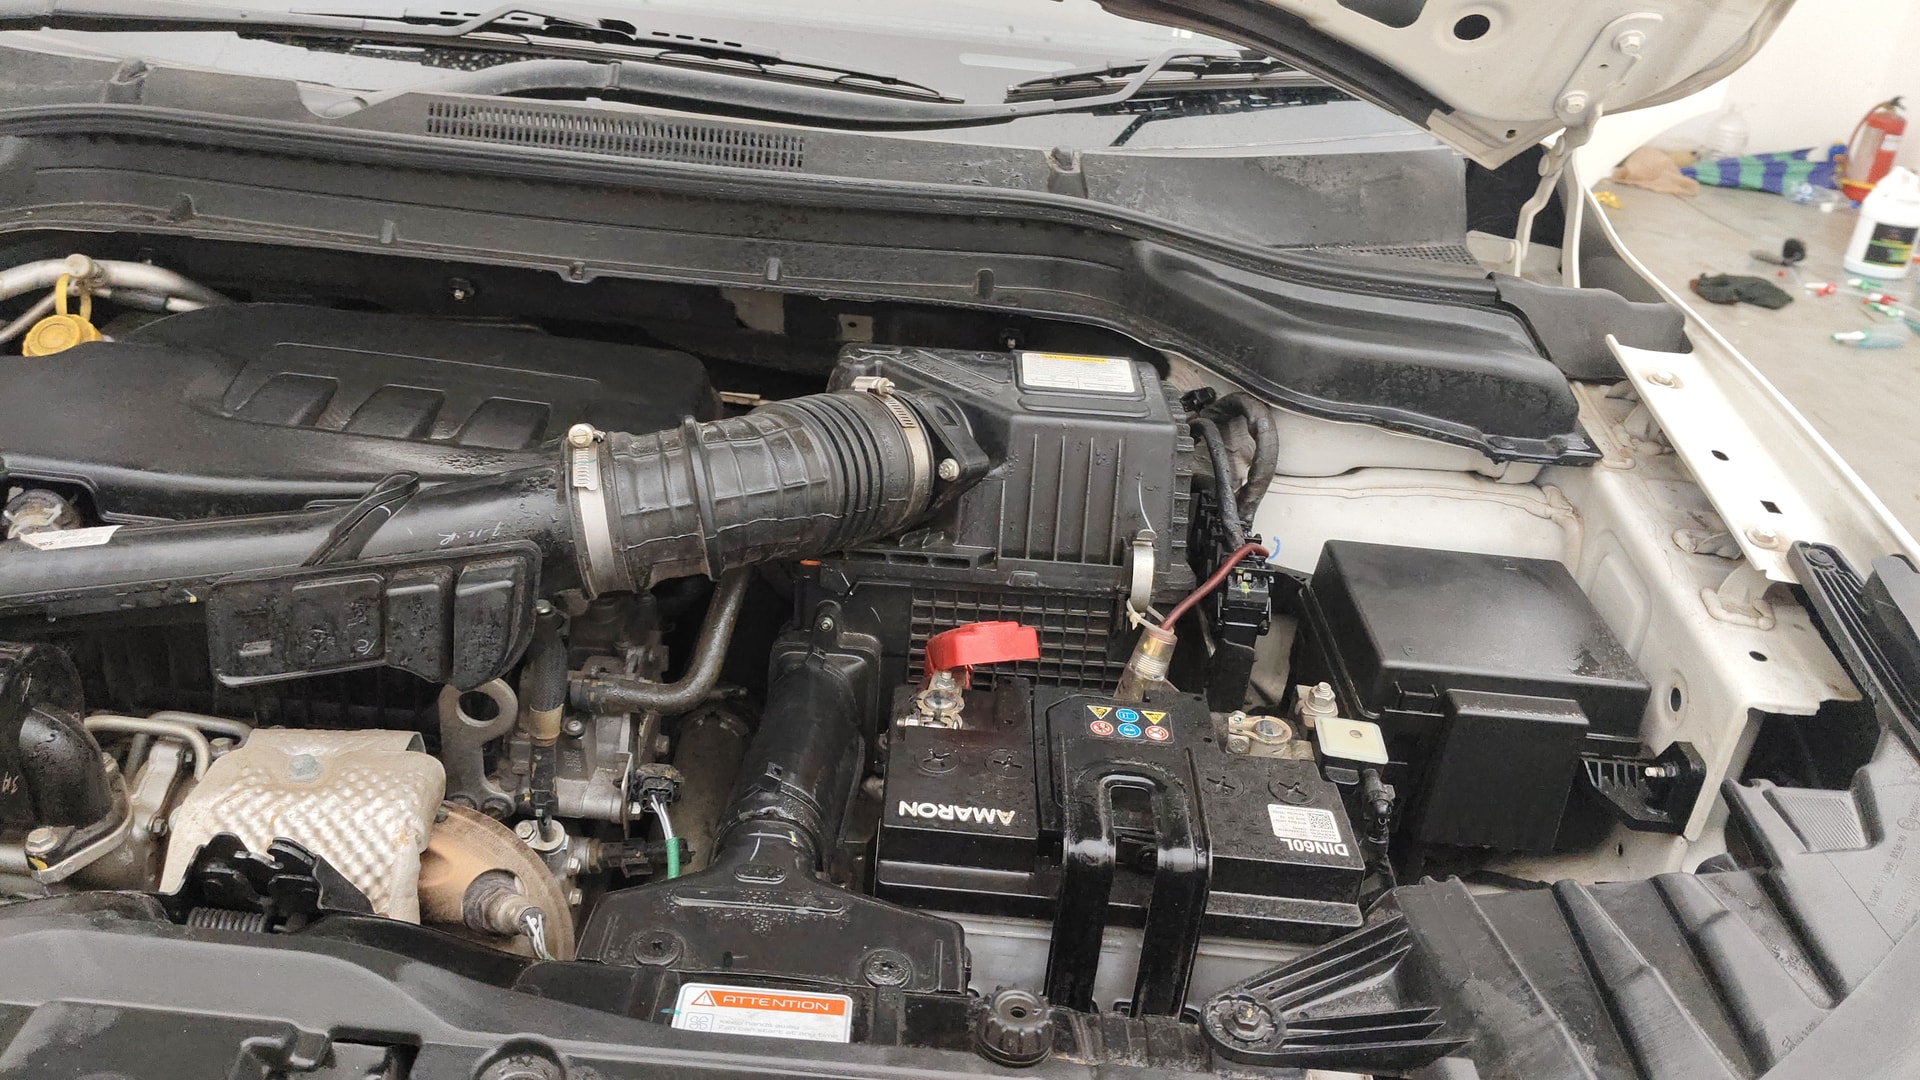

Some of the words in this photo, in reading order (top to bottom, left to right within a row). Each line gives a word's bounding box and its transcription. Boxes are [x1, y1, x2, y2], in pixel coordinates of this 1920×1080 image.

[898, 800, 1015, 826] AMARON
[1280, 838, 1349, 857] DIN60L
[722, 995, 829, 1011] ATTENTION
